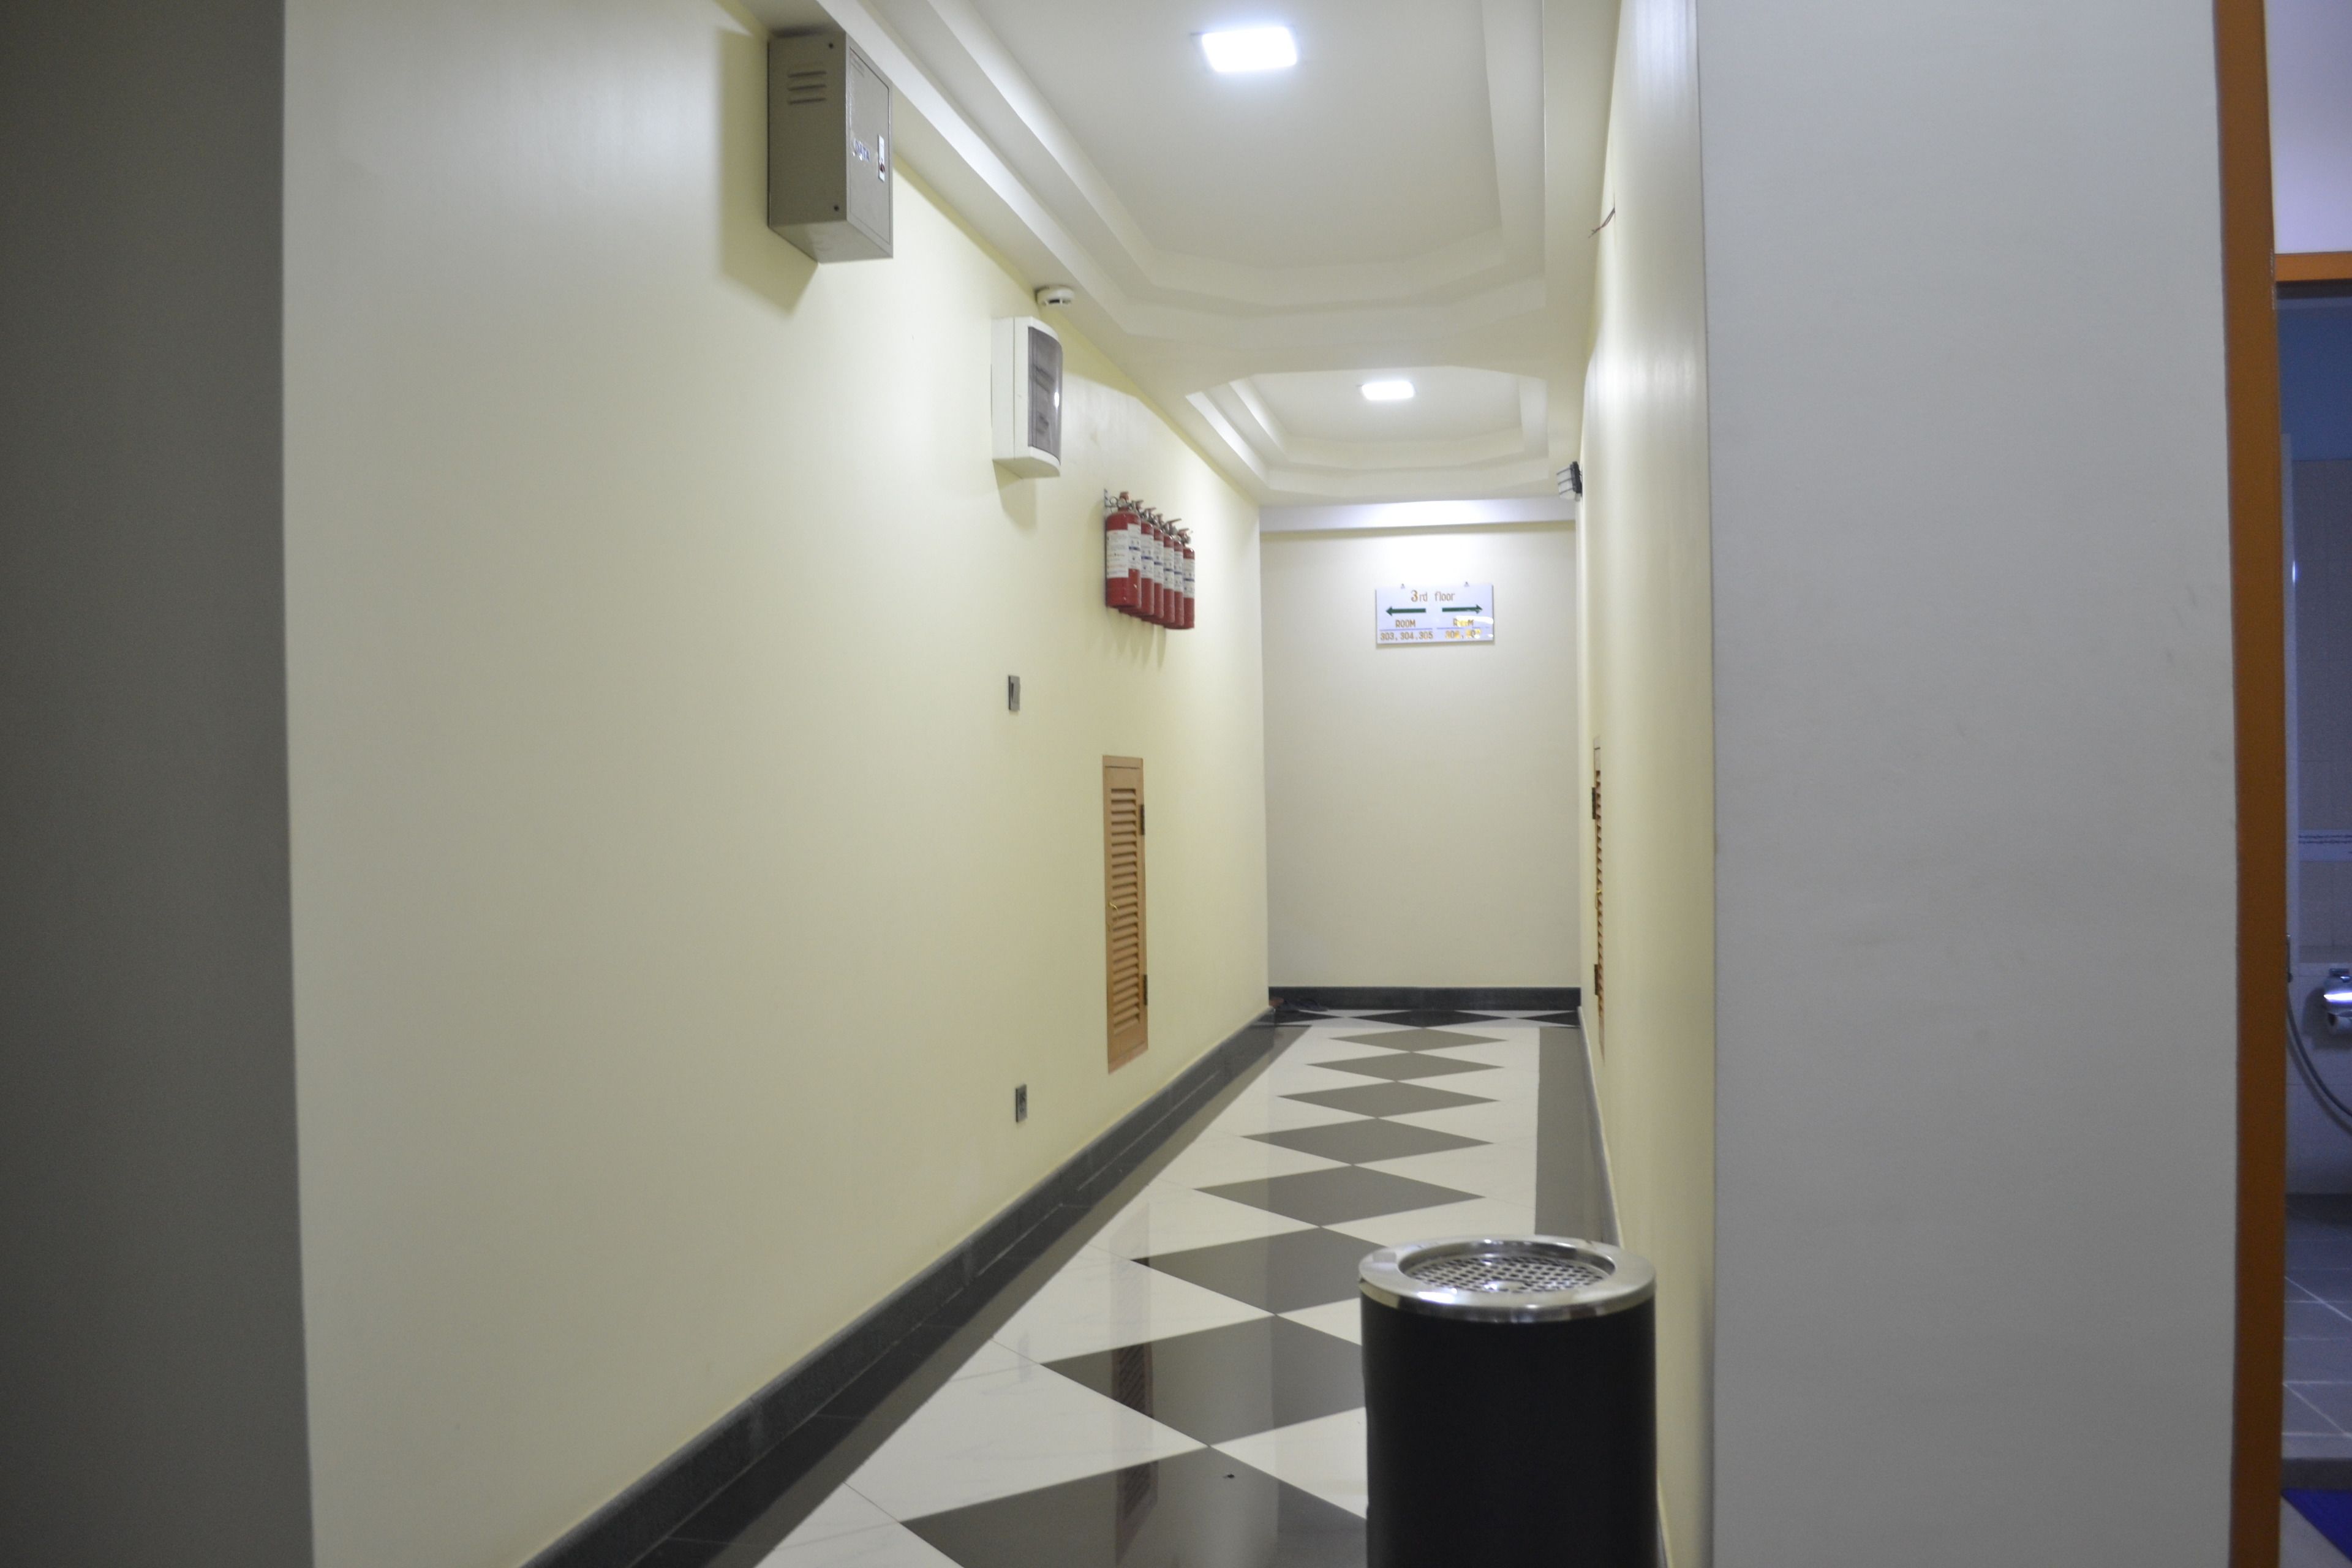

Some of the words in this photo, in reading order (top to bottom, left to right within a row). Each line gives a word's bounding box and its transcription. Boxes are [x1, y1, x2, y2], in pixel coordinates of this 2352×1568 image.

[1411, 589, 1428, 602] 3rd
[1434, 590, 1456, 602] floor
[1395, 619, 1416, 628] ROOM
